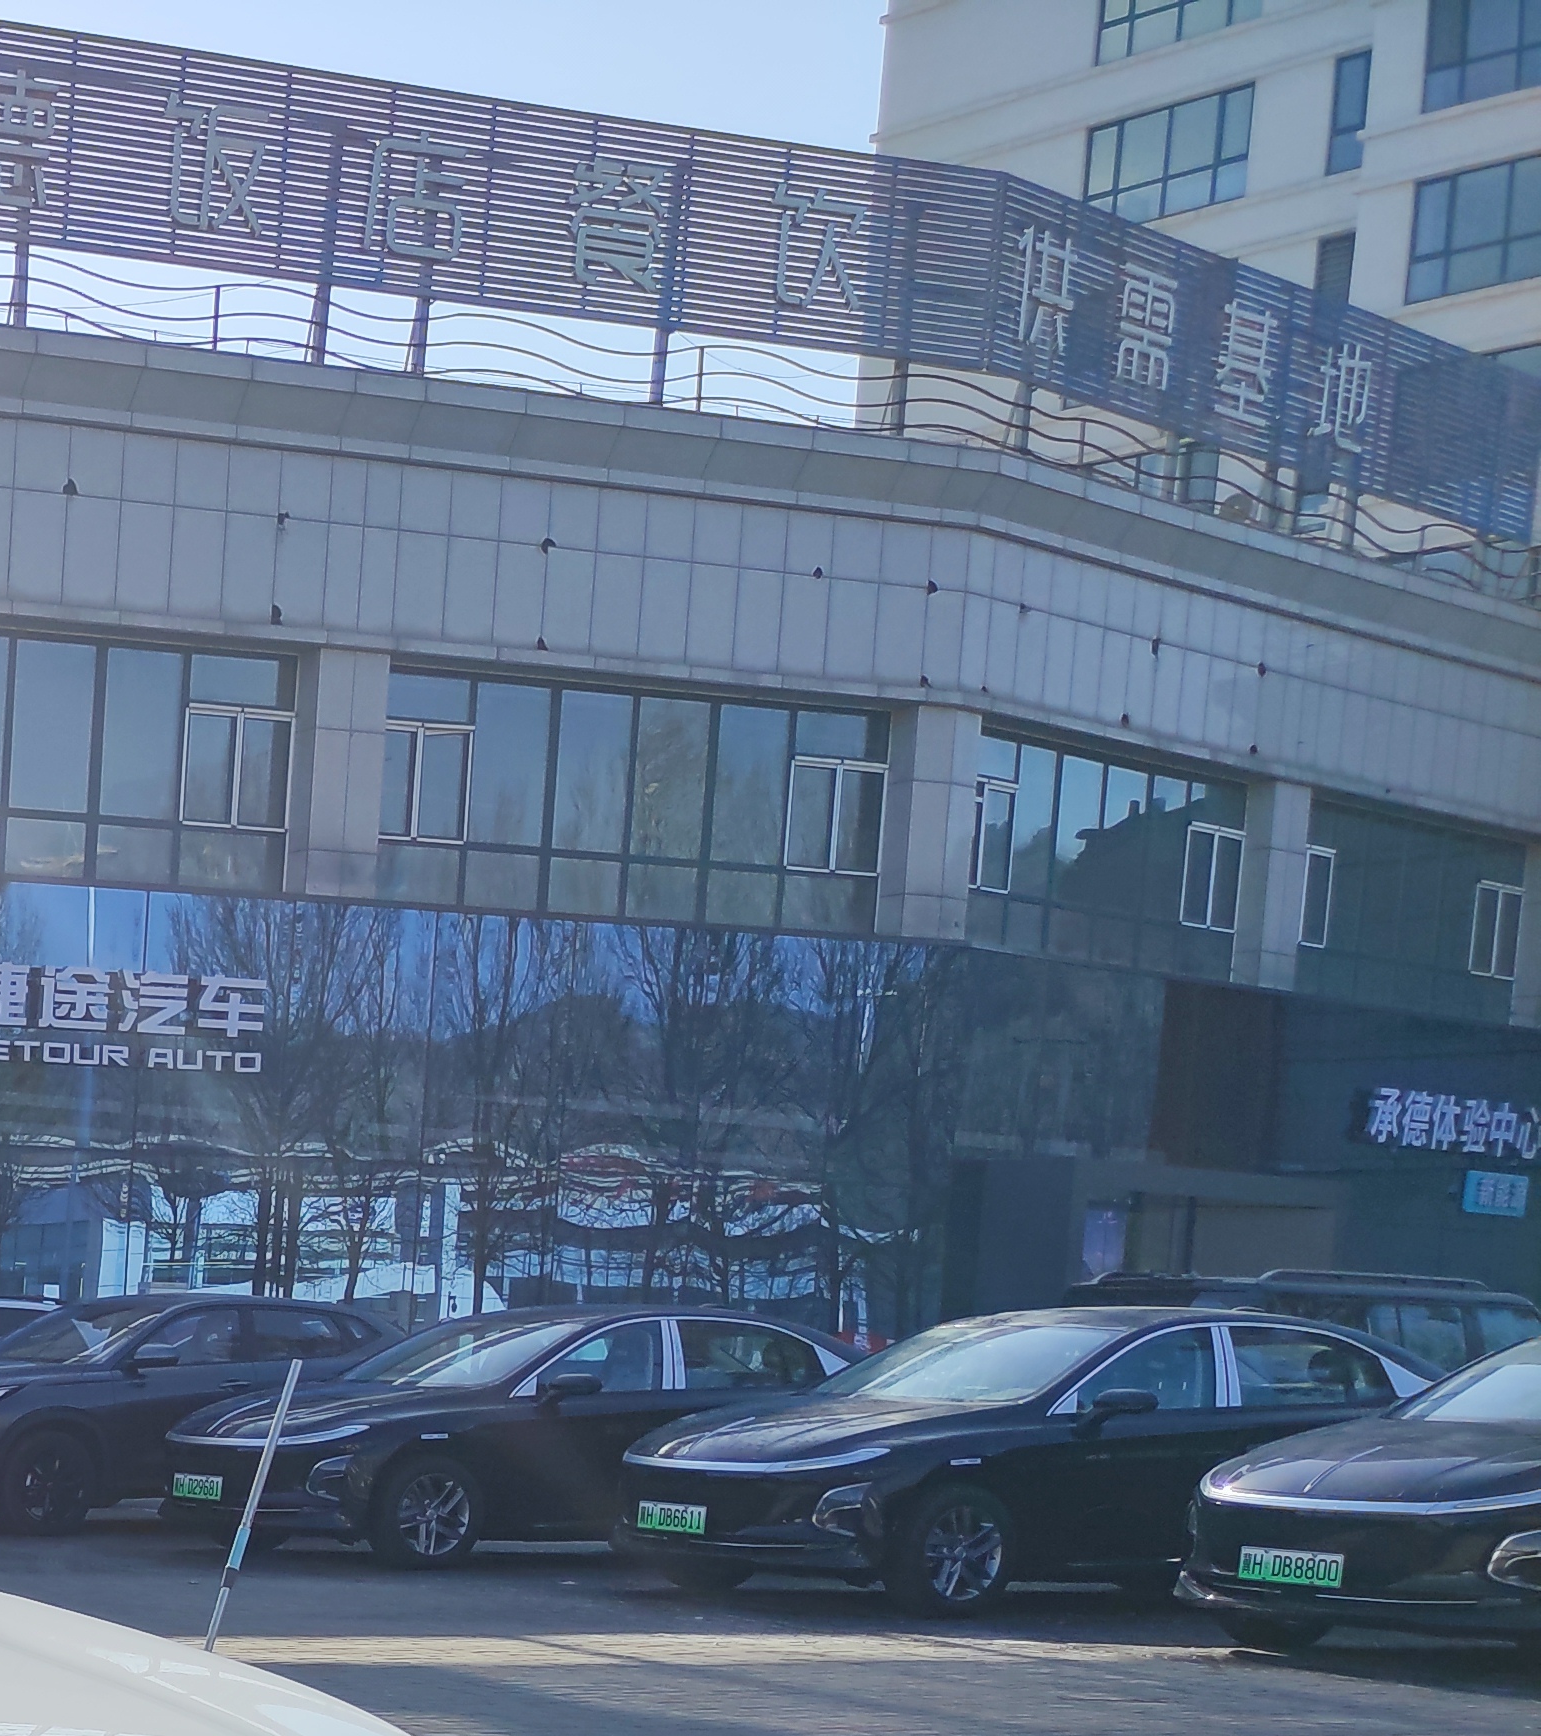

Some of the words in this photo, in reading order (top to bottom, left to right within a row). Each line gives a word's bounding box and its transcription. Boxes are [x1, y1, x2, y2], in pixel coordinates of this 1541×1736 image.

[147, 1047, 262, 1073] AUTO
[1368, 1087, 1541, 1160] 承德体验中心
